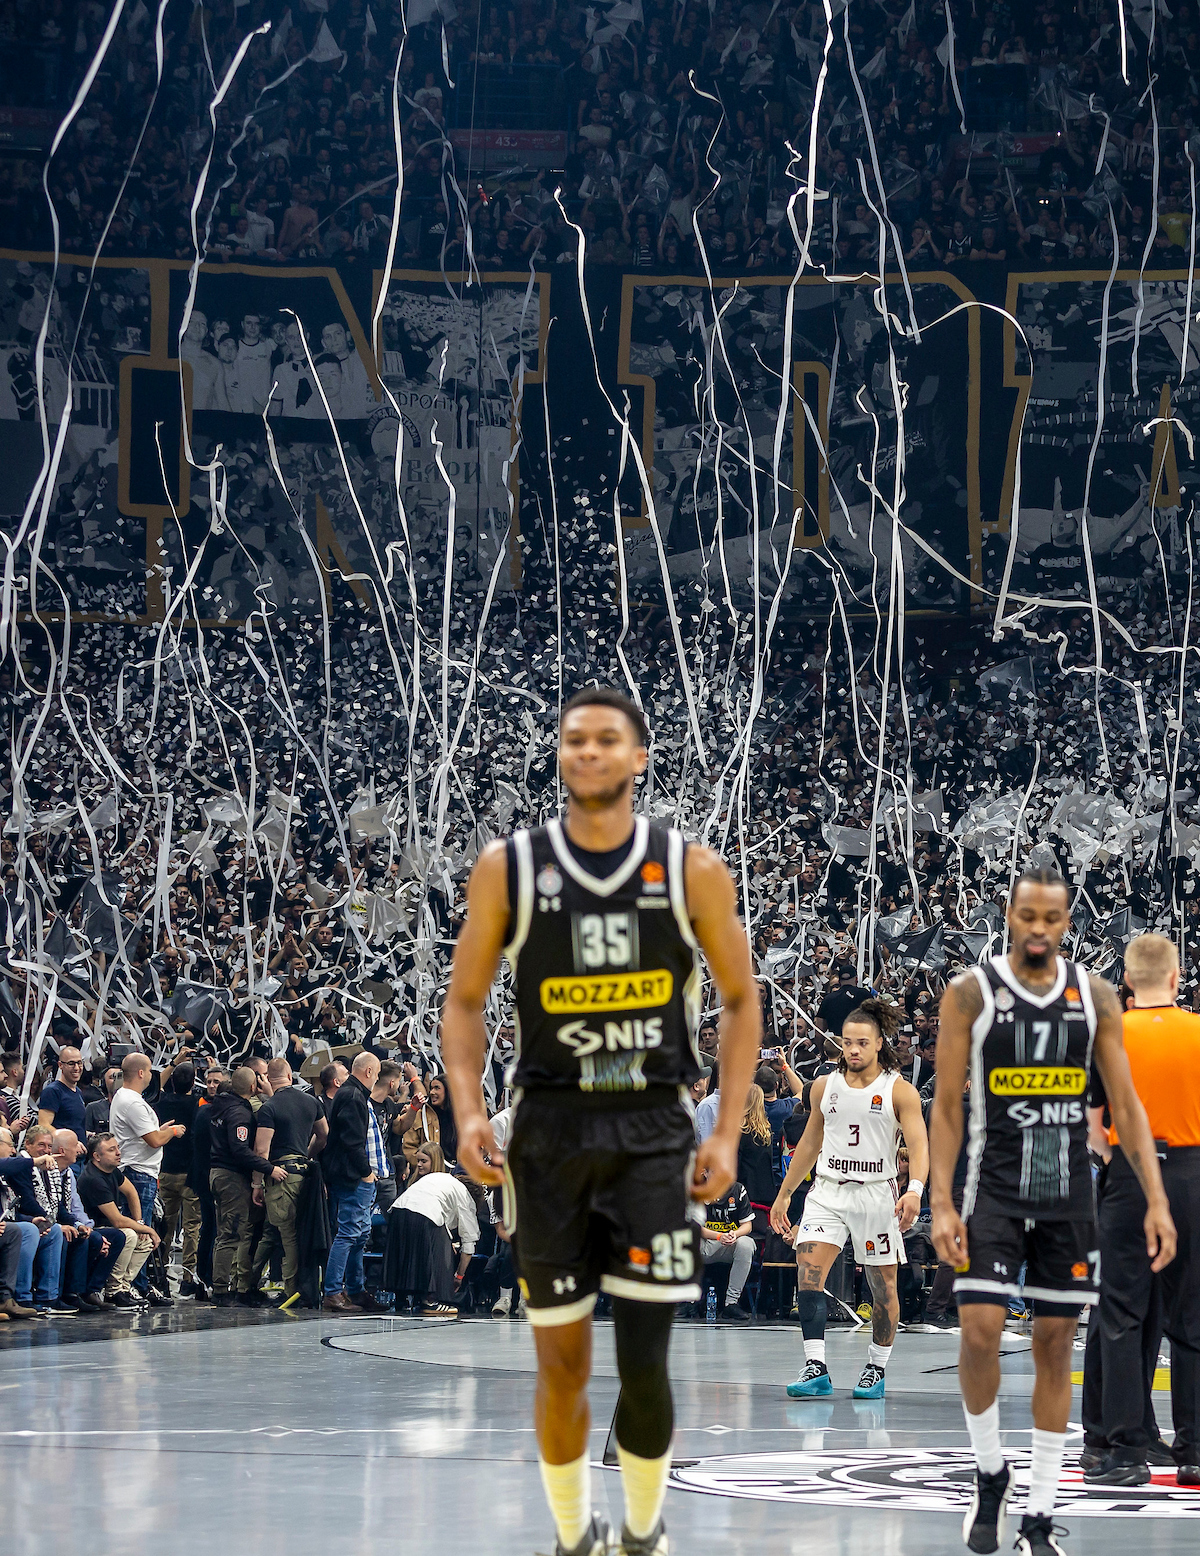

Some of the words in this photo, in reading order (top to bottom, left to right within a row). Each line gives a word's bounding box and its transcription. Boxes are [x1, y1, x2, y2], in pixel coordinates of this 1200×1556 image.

[580, 912, 631, 968] 35
[547, 975, 667, 1006] MOZZART
[605, 1017, 663, 1051] NIS
[1031, 1021, 1052, 1061] 7
[993, 1072, 1082, 1091] MOZZART
[1042, 1104, 1084, 1126] NIS
[848, 1124, 860, 1147] 3
[651, 1228, 695, 1281] 35
[877, 1232, 891, 1255] 3
[1086, 1249, 1102, 1288] 7
